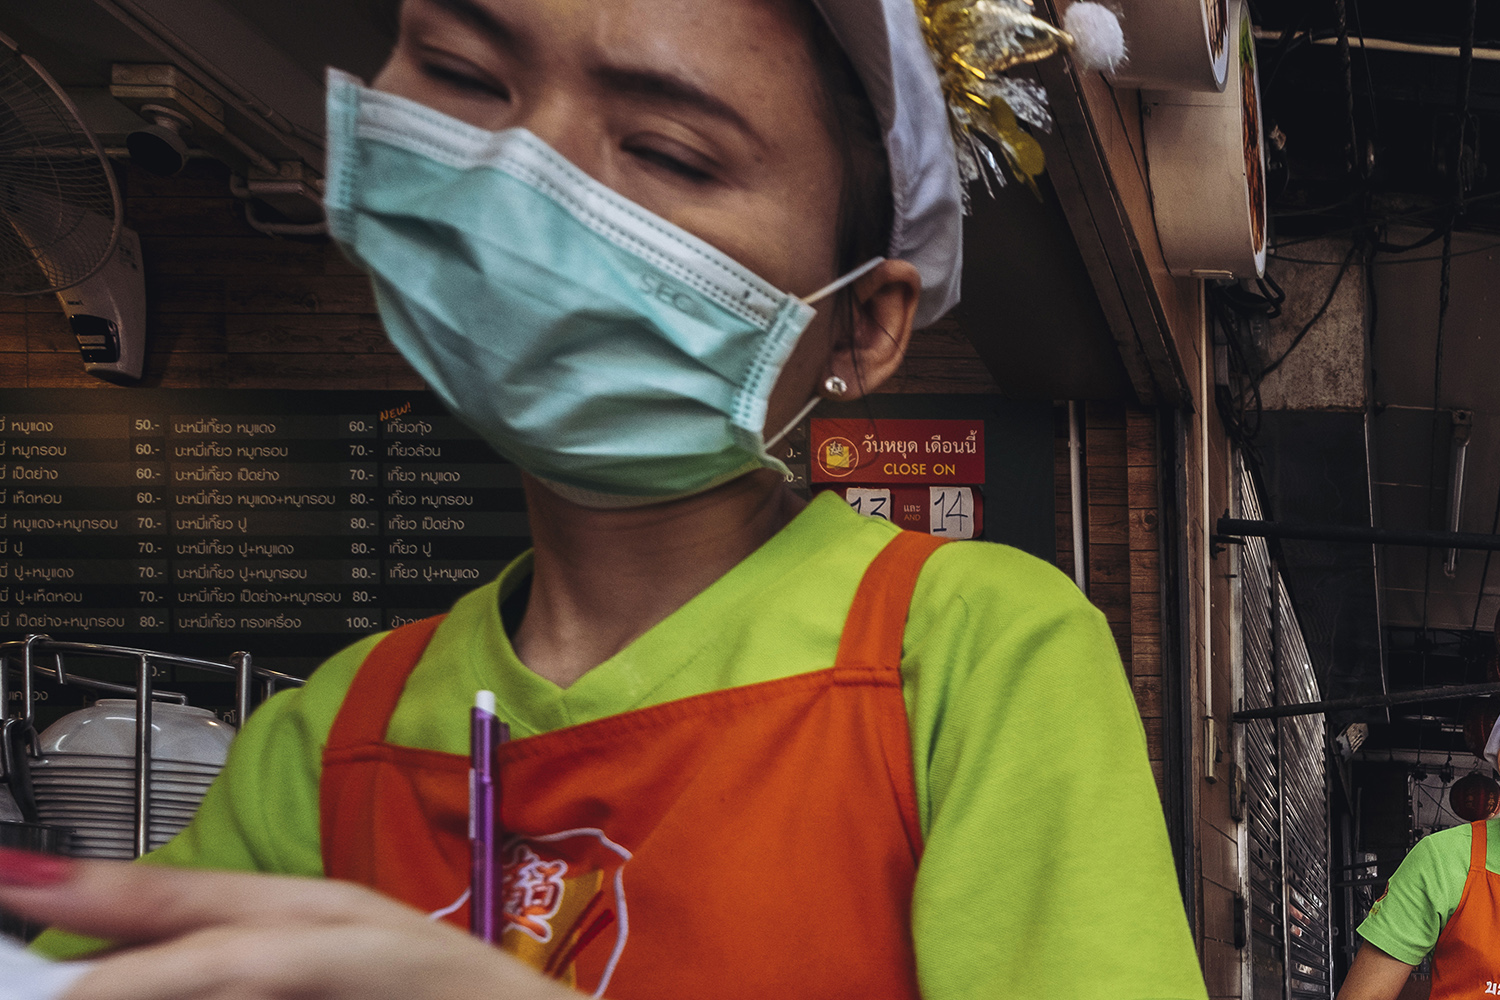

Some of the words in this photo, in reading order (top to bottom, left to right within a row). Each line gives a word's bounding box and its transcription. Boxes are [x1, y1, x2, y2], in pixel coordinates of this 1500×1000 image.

[380, 402, 411, 421] NEW!
[135, 419, 160, 430] 50.-
[349, 421, 373, 432] 60.-
[135, 444, 160, 455] 60.-
[862, 434, 918, 459] วันหยุด
[925, 430, 977, 454] เดือนนี้
[350, 445, 374, 456] 70.-
[136, 468, 161, 479] 60.-
[350, 469, 374, 480] 70.-
[883, 463, 927, 476] CLOSE
[933, 463, 956, 476] ON
[137, 492, 161, 503] 60.-
[350, 493, 374, 504] 80.-
[903, 504, 921, 513] และ
[933, 491, 968, 532] 14
[137, 517, 162, 529] 70.-
[350, 518, 375, 529] 80.-
[138, 542, 162, 553] 70.-
[351, 543, 375, 554] 80.-
[139, 567, 163, 578] 70.-
[352, 568, 376, 579] 80.-
[139, 591, 163, 602] 70.-
[352, 591, 377, 603] 80.-
[139, 616, 164, 627] 80.-
[346, 617, 378, 629] 100.-
